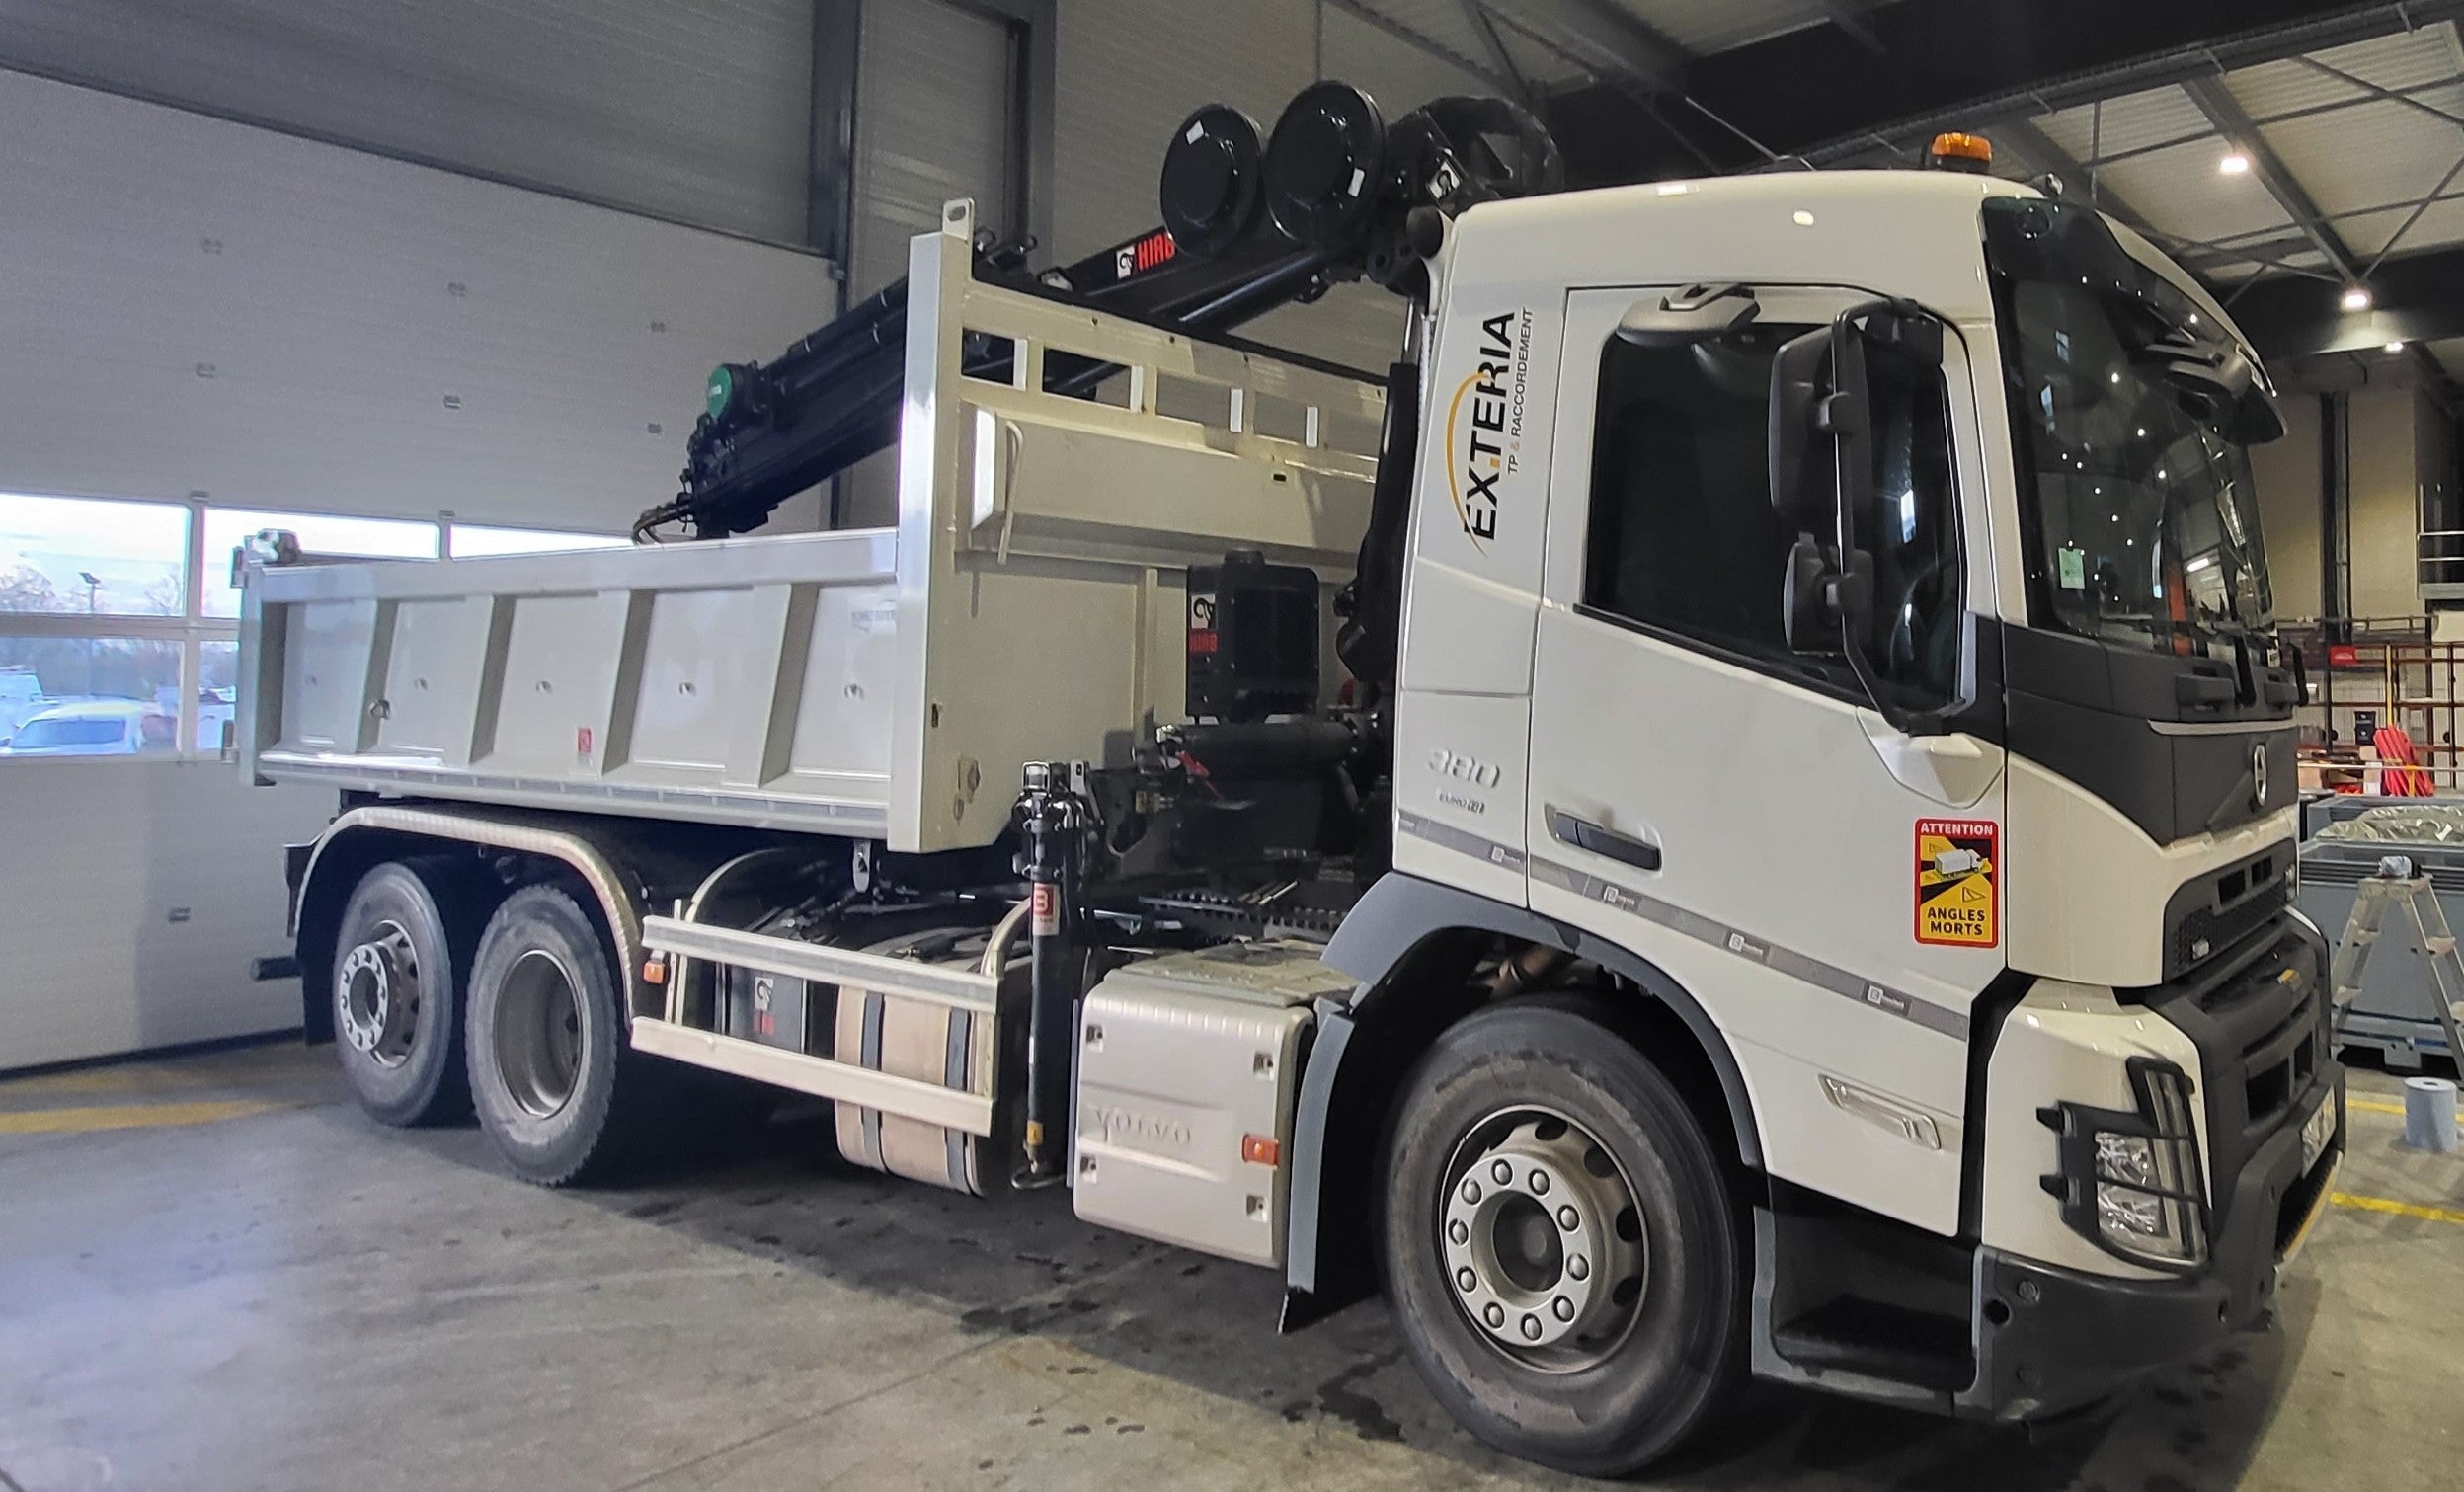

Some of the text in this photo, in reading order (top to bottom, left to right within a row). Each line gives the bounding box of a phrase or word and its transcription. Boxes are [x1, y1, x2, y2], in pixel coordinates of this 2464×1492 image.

[1511, 307, 1534, 438] RACCORDEMENT
[1508, 454, 1520, 475] TP
[1920, 823, 1993, 836] ATTENTION
[1927, 906, 1986, 922] ANGLES
[1930, 920, 1983, 936] MORTS
[1095, 1107, 1191, 1145] VOLVO
